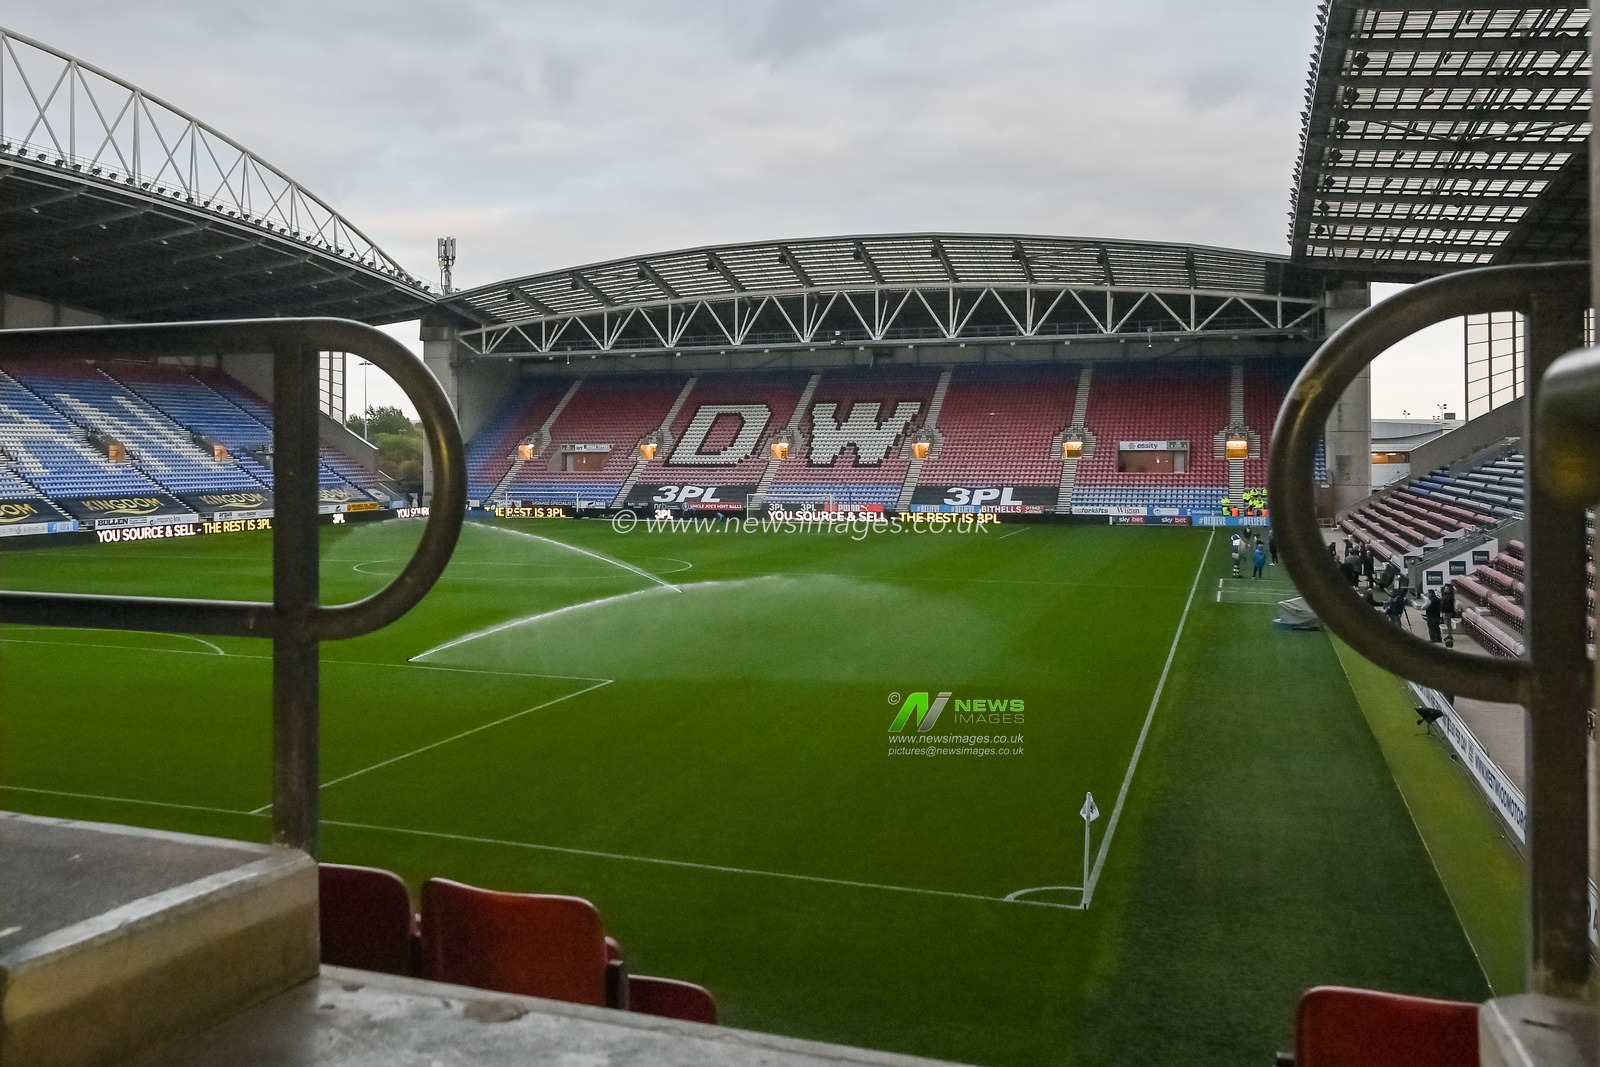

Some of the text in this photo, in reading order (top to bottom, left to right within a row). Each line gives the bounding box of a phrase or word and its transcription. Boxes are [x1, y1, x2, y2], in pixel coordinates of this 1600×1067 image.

[653, 485, 720, 502] 3PL
[943, 487, 1023, 505] 3PL
[81, 497, 164, 511] KINGDOM
[199, 493, 267, 505] KINGDOM
[534, 507, 544, 517] IS
[547, 507, 566, 517] 3PL
[769, 503, 785, 511] 3PL
[801, 503, 816, 511] 3PL
[981, 505, 1022, 513] BITHELLS
[397, 508, 410, 518] YOU
[654, 509, 673, 519] 3PL
[768, 511, 793, 521] YOU
[795, 511, 845, 521] SOURCE
[847, 511, 856, 521] &
[858, 511, 887, 522] SELL
[899, 512, 924, 522] THE
[927, 512, 959, 523] REST
[962, 513, 974, 523] IS
[976, 513, 1001, 524] 3PL
[97, 518, 129, 526] BULLEN
[97, 528, 120, 542] YOU
[122, 525, 164, 541] SOURCE
[165, 525, 173, 537] &
[174, 523, 196, 537] SELL
[203, 521, 222, 534] THE
[223, 520, 246, 532] REST
[247, 519, 256, 531] IS
[257, 518, 272, 530] 3PL
